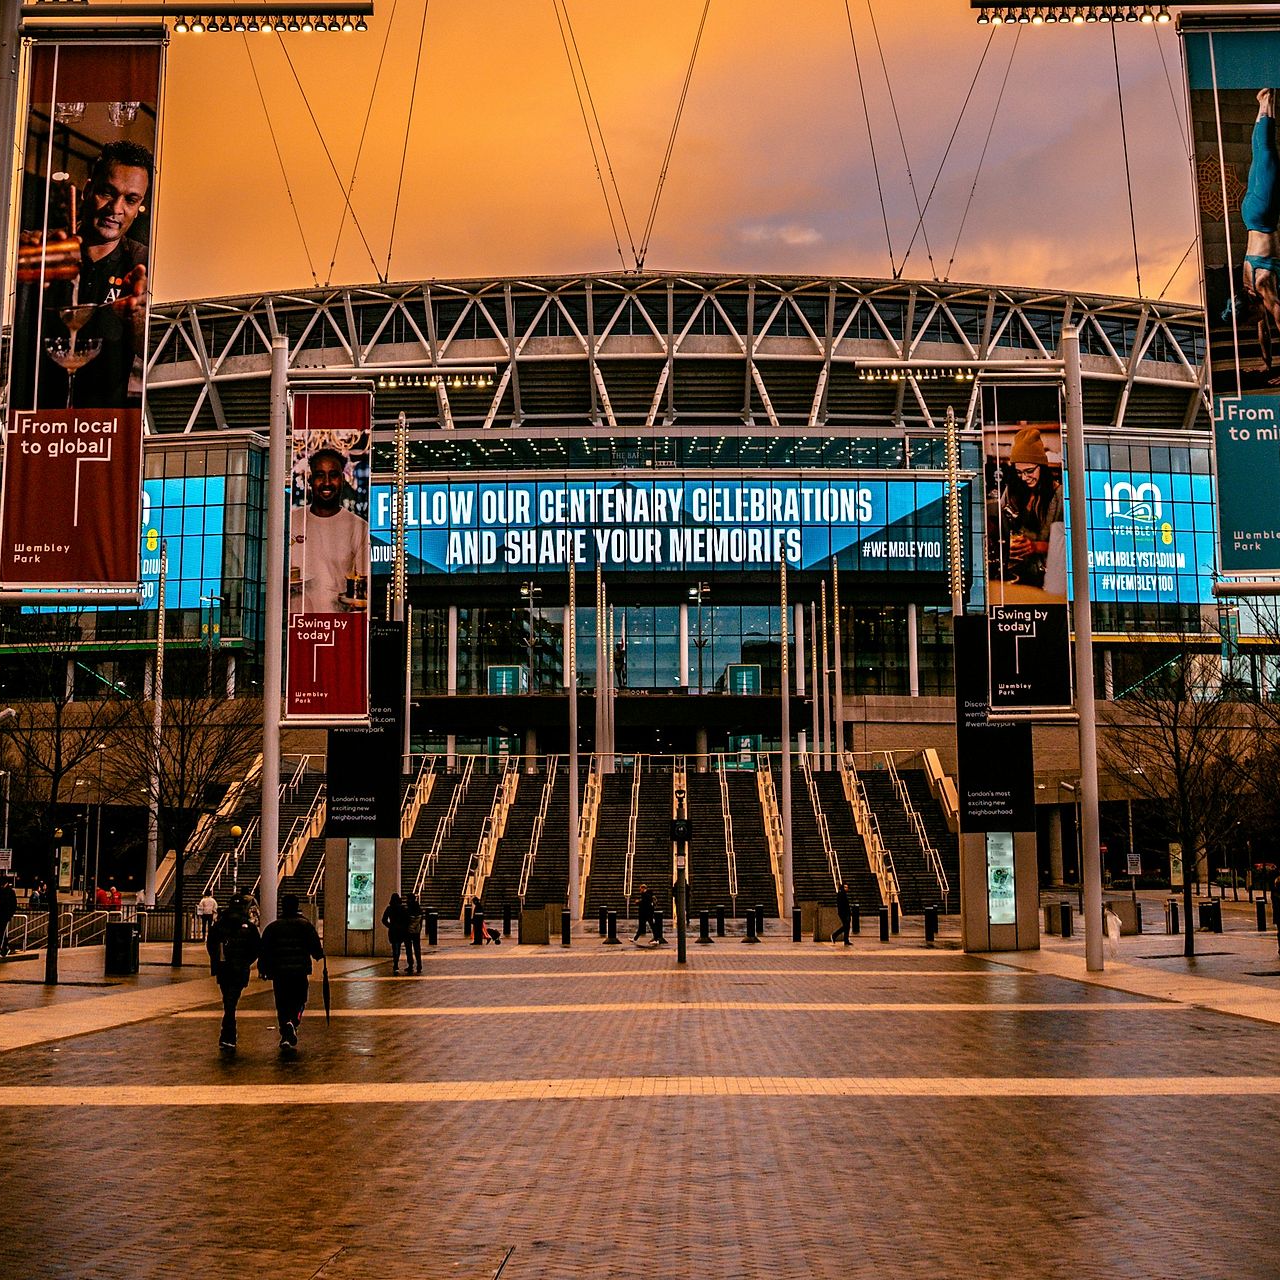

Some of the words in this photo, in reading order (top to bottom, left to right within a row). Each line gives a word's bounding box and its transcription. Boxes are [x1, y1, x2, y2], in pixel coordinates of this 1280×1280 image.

[1228, 404, 1274, 420] From
[21, 418, 68, 434] From
[73, 417, 118, 434] local
[1228, 426, 1251, 441] to
[20, 439, 42, 454] to
[47, 437, 104, 458] global
[482, 489, 531, 524] OUR
[539, 487, 684, 523] CENTENARY
[692, 487, 873, 523] CELEBRATIONS
[1108, 524, 1158, 537] WEMBLEY
[14, 543, 71, 554] Wembley
[445, 530, 497, 566] AND
[504, 529, 587, 565] SHARE
[593, 528, 662, 564] YOUR
[669, 528, 802, 564] MEMORIES
[861, 541, 942, 559] #WEMBLEY100
[1234, 541, 1261, 551] Park
[13, 554, 41, 563] Park
[1101, 573, 1174, 592] #WEMBLEY100
[997, 610, 1031, 621] Swing
[1034, 609, 1048, 621] by
[297, 618, 331, 630] Swing
[334, 618, 348, 630] by
[997, 621, 1031, 633] today
[297, 630, 330, 642] today
[967, 808, 1013, 816] neighbourhood
